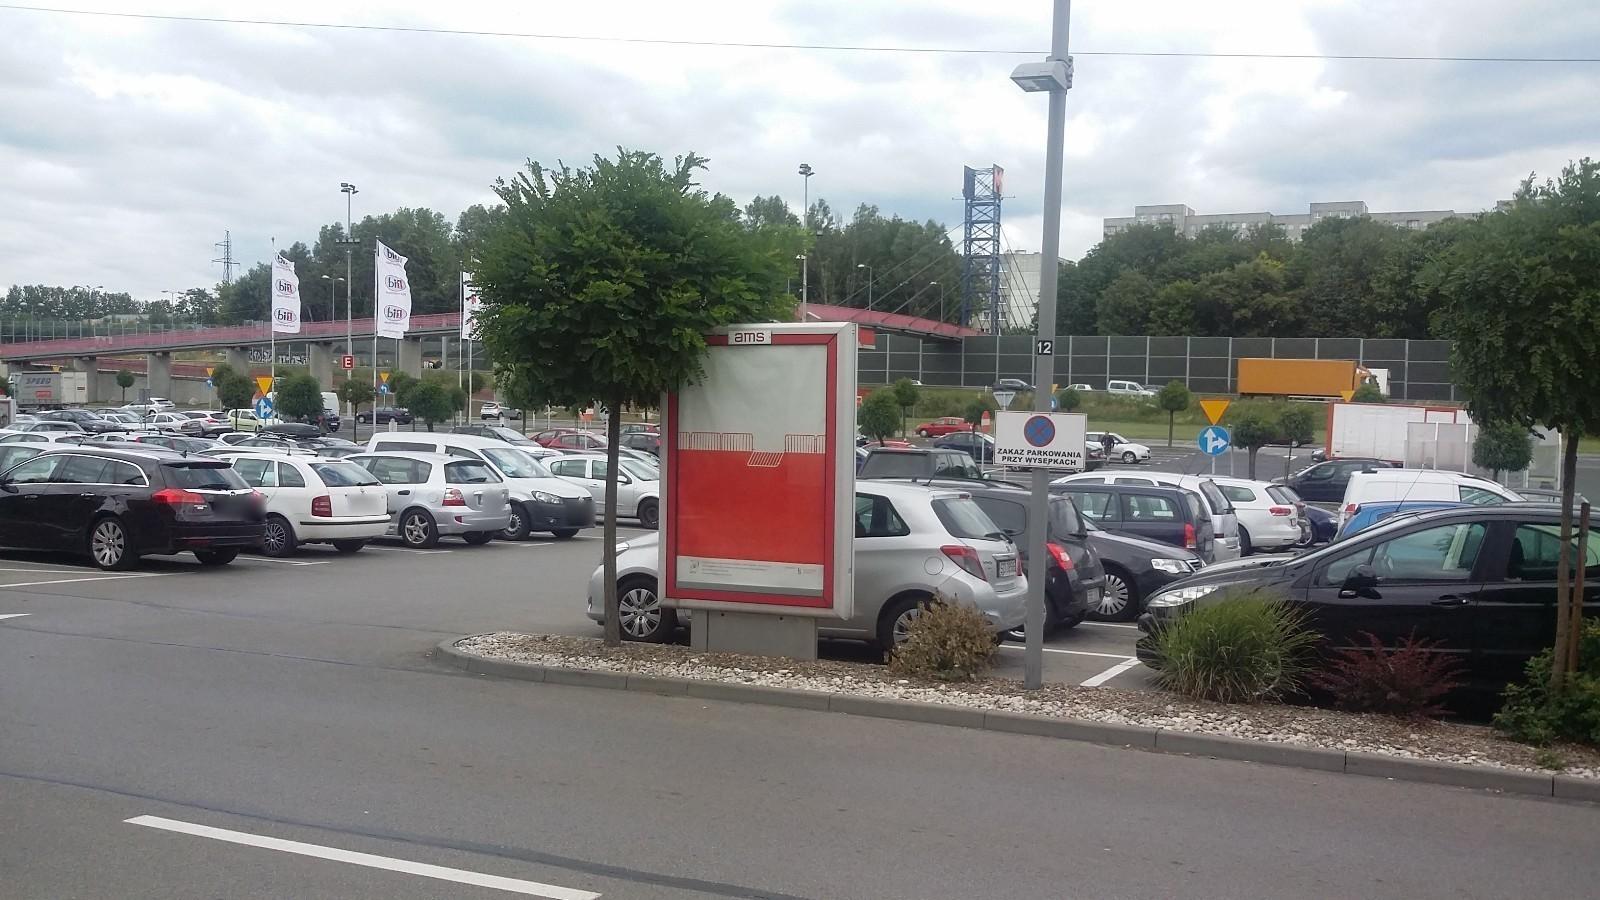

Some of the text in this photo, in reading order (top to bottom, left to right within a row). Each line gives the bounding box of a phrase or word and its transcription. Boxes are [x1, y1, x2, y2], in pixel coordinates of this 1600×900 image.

[734, 332, 765, 343] ams
[1037, 341, 1051, 354] 12
[345, 357, 352, 368] E
[997, 448, 1082, 458] ZAKAZ PARKOWANIA
[1025, 457, 1077, 466] WYSEPKACH
